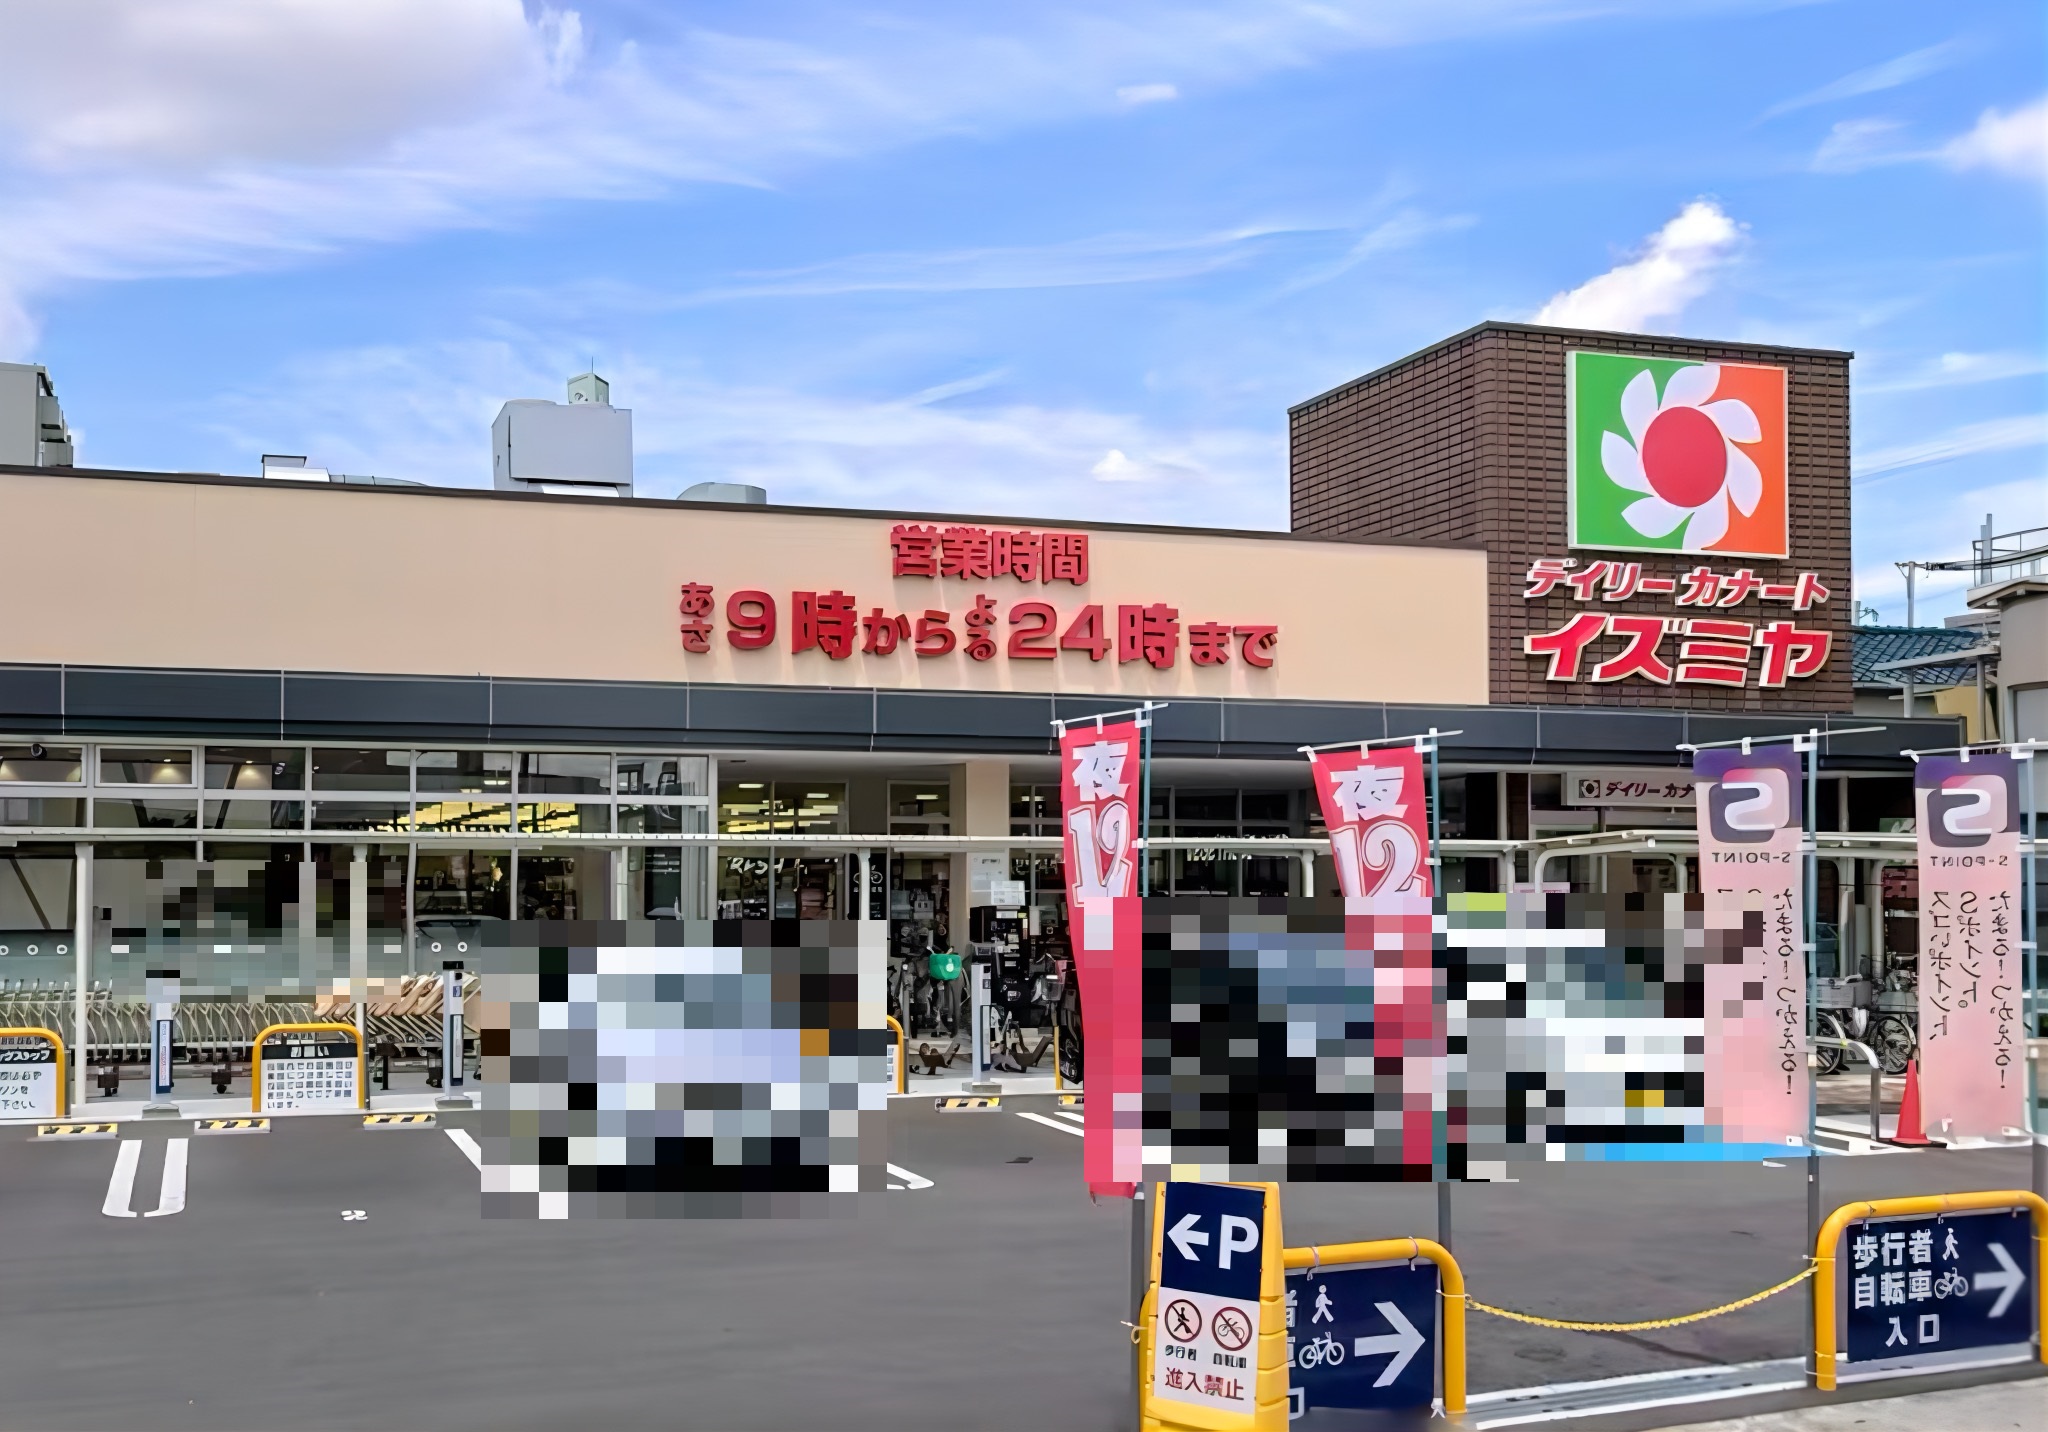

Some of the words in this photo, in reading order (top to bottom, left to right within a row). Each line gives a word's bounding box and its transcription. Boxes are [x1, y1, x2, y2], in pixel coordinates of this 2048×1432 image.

[891, 524, 1088, 585] 営業時間
[1524, 612, 1833, 687] イズミヤ
[1218, 1214, 1260, 1270] P
[1852, 1228, 1934, 1270] 歩行者
[1854, 1268, 1933, 1310] 自転車
[1885, 1313, 1941, 1348] 入口
